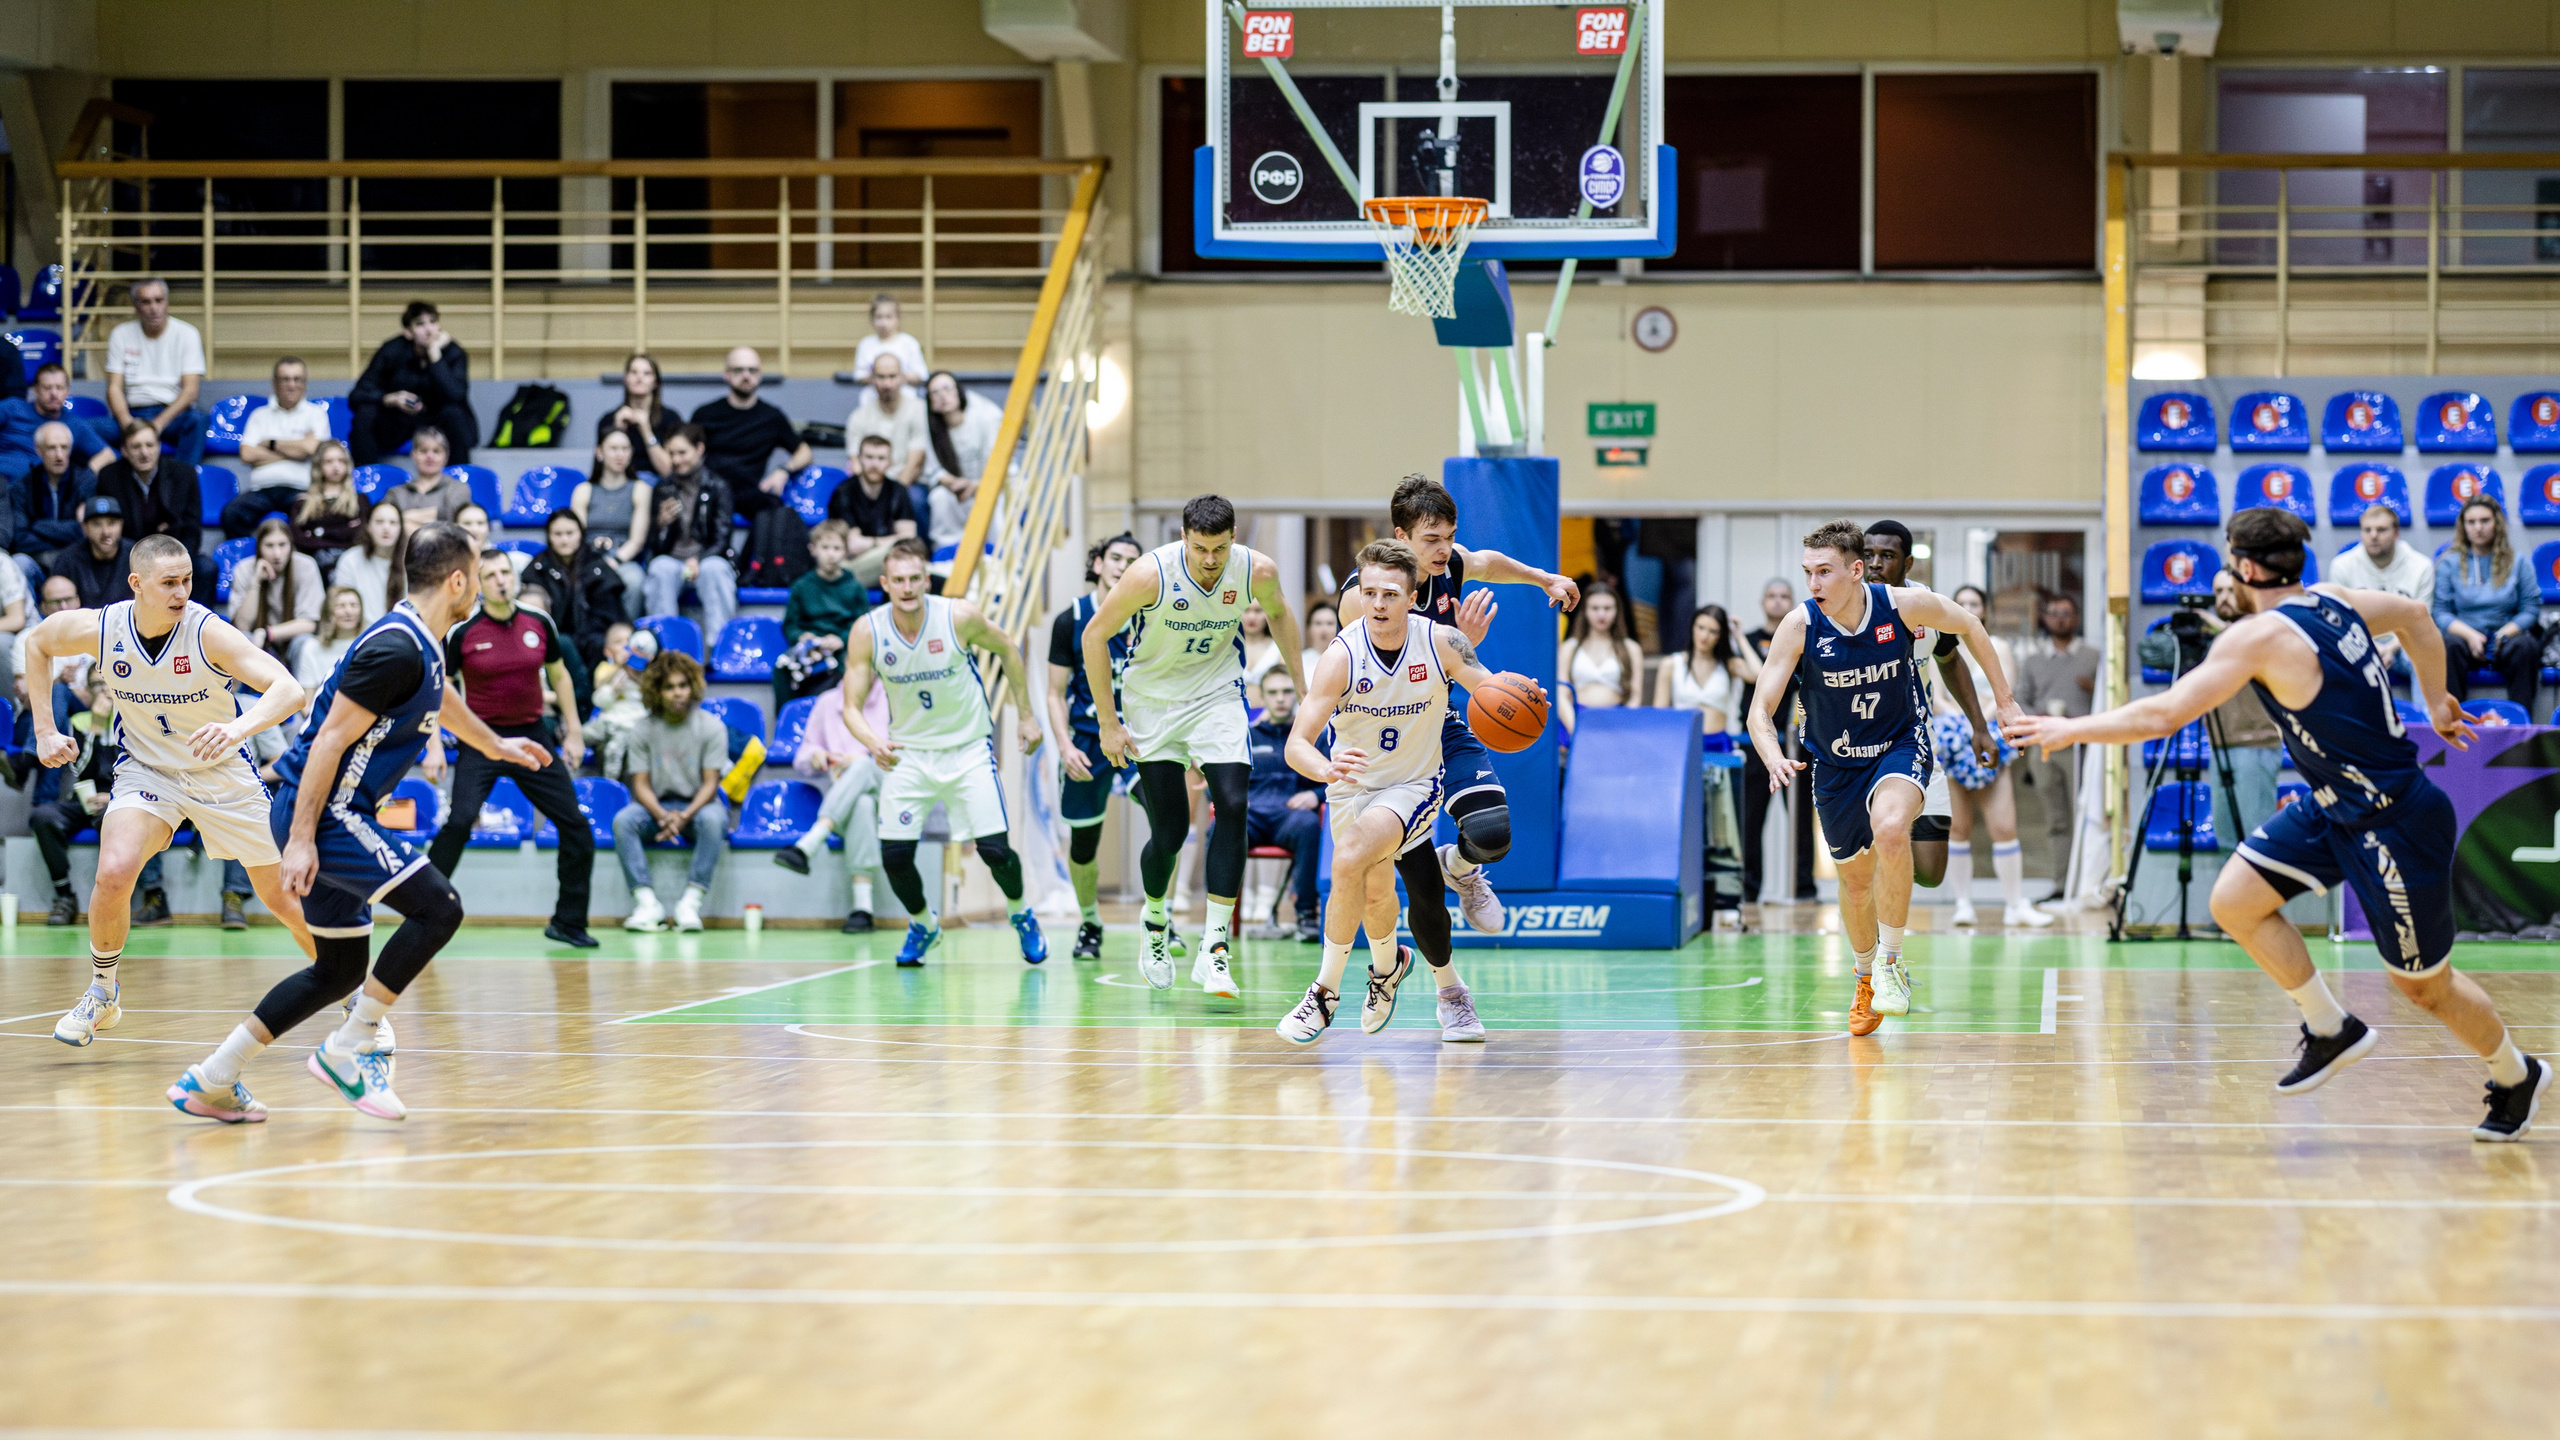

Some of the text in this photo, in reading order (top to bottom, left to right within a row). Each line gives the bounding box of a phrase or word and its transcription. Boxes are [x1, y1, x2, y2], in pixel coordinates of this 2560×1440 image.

[1246, 16, 1291, 34] FON
[1579, 12, 1624, 31] FON
[1246, 33, 1291, 52] BET
[1579, 30, 1625, 49] BET
[1257, 170, 1297, 186] РФБ
[1595, 410, 1647, 429] EXIT
[2353, 407, 2366, 425] E
[2447, 406, 2460, 425] E
[2539, 402, 2551, 420] E
[2270, 477, 2283, 495] E
[2362, 477, 2375, 495] E
[2459, 479, 2472, 497] E
[1876, 626, 1892, 634] FON
[1878, 632, 1893, 642] BET
[1183, 635, 1213, 654] 15
[176, 664, 190, 673] BET
[1410, 666, 1425, 675] FON
[1411, 672, 1426, 681] BET
[1822, 659, 1900, 688] ЗЕНИТ
[918, 690, 933, 710] 9
[1851, 691, 1881, 720] 47
[155, 713, 177, 737] 1
[1378, 725, 1401, 754] 8
[1502, 906, 1610, 932] YSTEM
